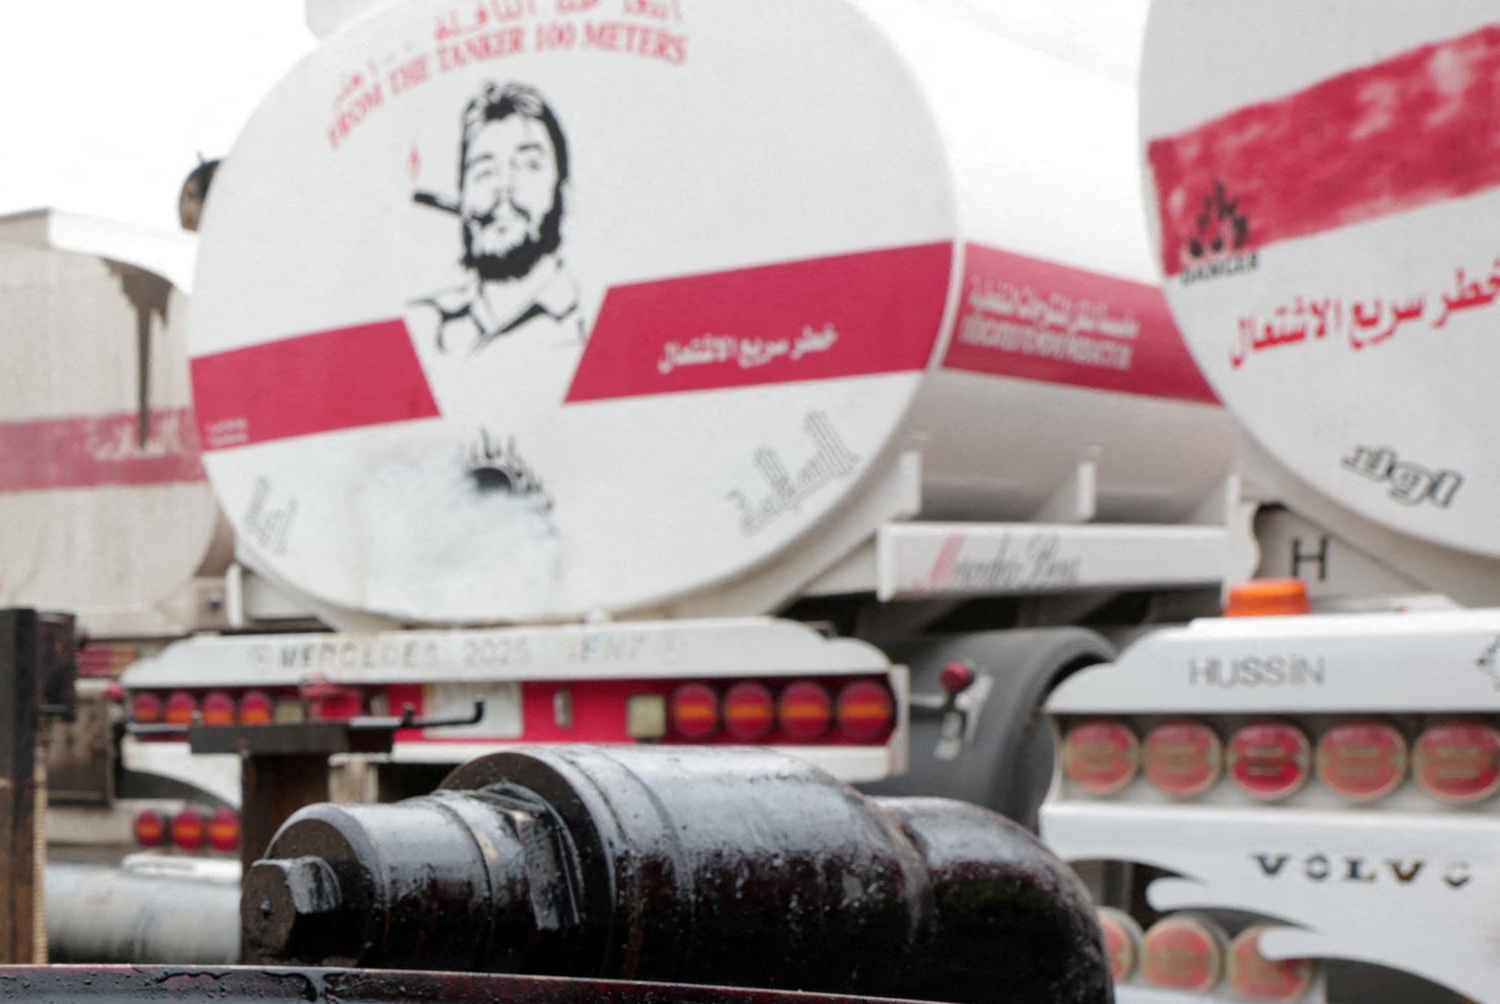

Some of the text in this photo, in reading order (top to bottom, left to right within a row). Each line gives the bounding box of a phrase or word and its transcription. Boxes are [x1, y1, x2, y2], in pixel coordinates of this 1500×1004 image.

[436, 27, 526, 72] TANKER
[535, 22, 577, 51] 100
[583, 21, 688, 66] METERS
[1252, 853, 1473, 888] VOLVO
